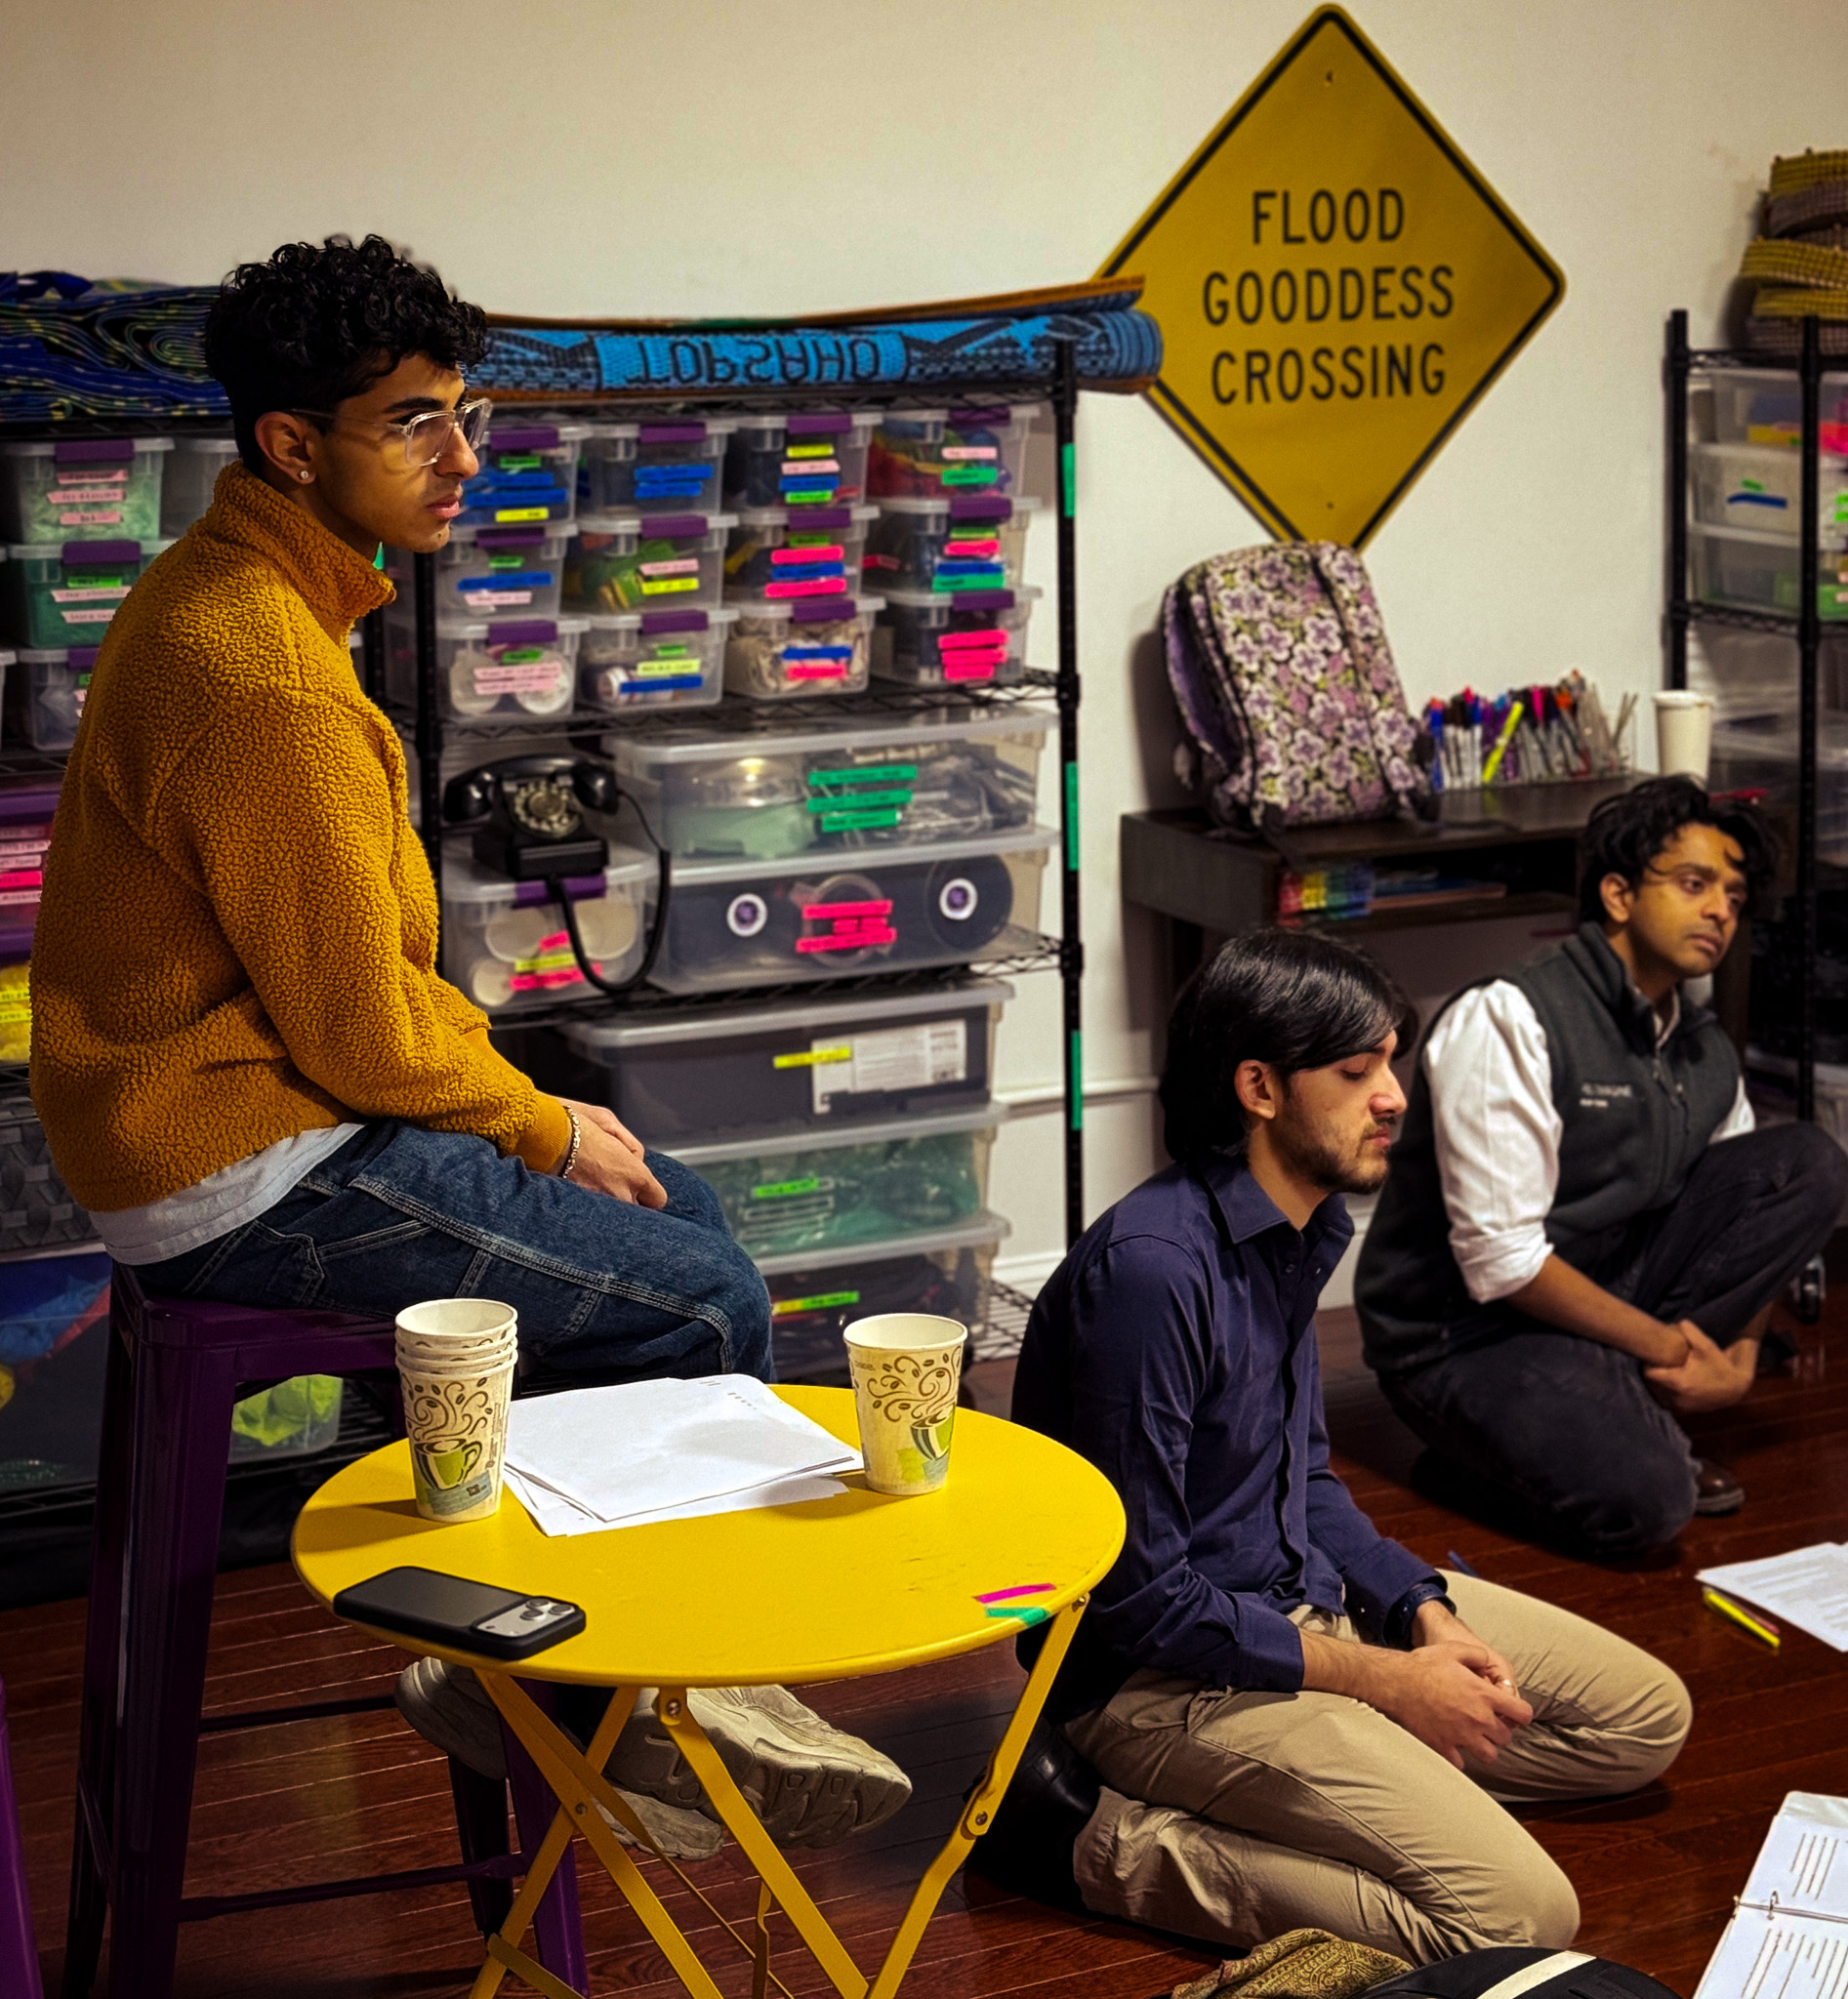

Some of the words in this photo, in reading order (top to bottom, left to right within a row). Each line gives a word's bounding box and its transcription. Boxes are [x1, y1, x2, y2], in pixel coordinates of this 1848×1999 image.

[1252, 188, 1405, 245] FLOOD
[1203, 265, 1455, 327] GOODDESS
[1211, 343, 1446, 406] CROSSING
